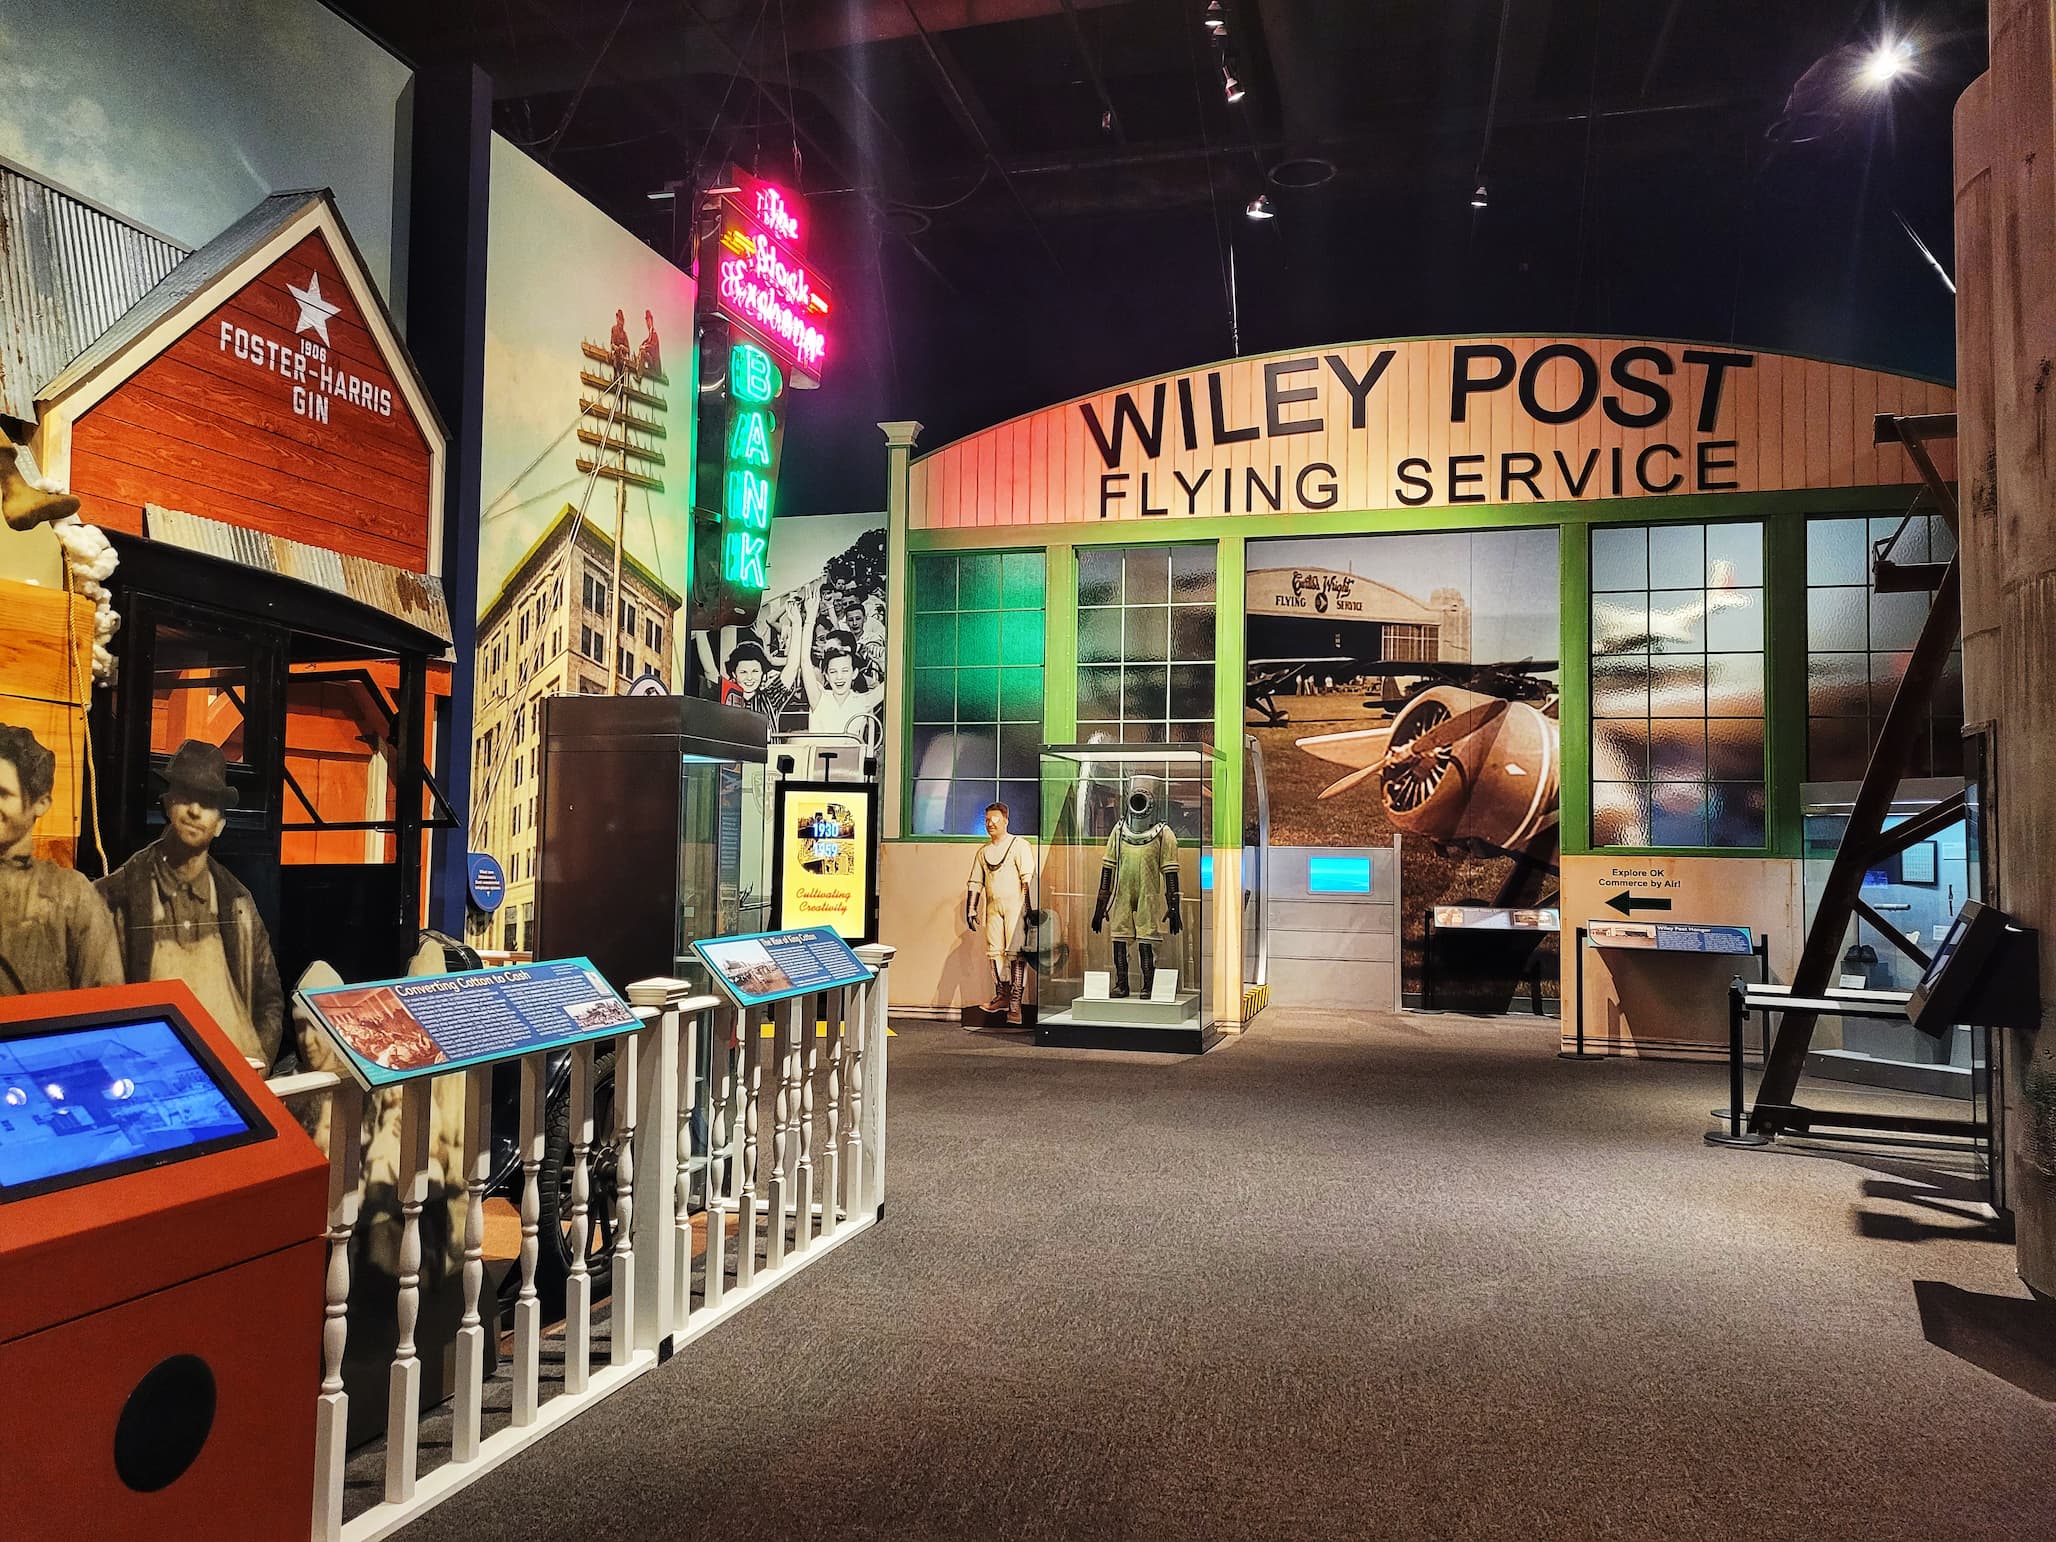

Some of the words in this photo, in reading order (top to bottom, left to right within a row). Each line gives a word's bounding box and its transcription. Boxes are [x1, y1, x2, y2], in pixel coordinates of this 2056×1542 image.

[760, 188, 799, 240] The
[754, 234, 809, 306] Stock
[300, 338, 328, 364] 1906
[220, 320, 392, 417] FOSTER-HARRIS
[292, 385, 329, 425] GIN
[1079, 350, 1397, 469] WILEY
[1449, 344, 1754, 433] POST
[733, 344, 772, 589] BANK
[1100, 462, 1339, 518] FLYING
[1395, 440, 1740, 506] SERVICE
[1275, 595, 1306, 608] FLYING
[812, 823, 839, 838] 1930
[1598, 878, 1648, 887] Commerce
[1651, 879, 1662, 889] by
[1664, 880, 1681, 888] Air!
[1612, 868, 1647, 878] Explore
[1650, 869, 1664, 877] OK
[796, 887, 851, 901] Cultivating
[799, 901, 848, 915] Creativity
[394, 980, 460, 997] Converting
[457, 977, 492, 989] Cotton
[492, 974, 505, 984] to
[504, 970, 532, 983] Cash
